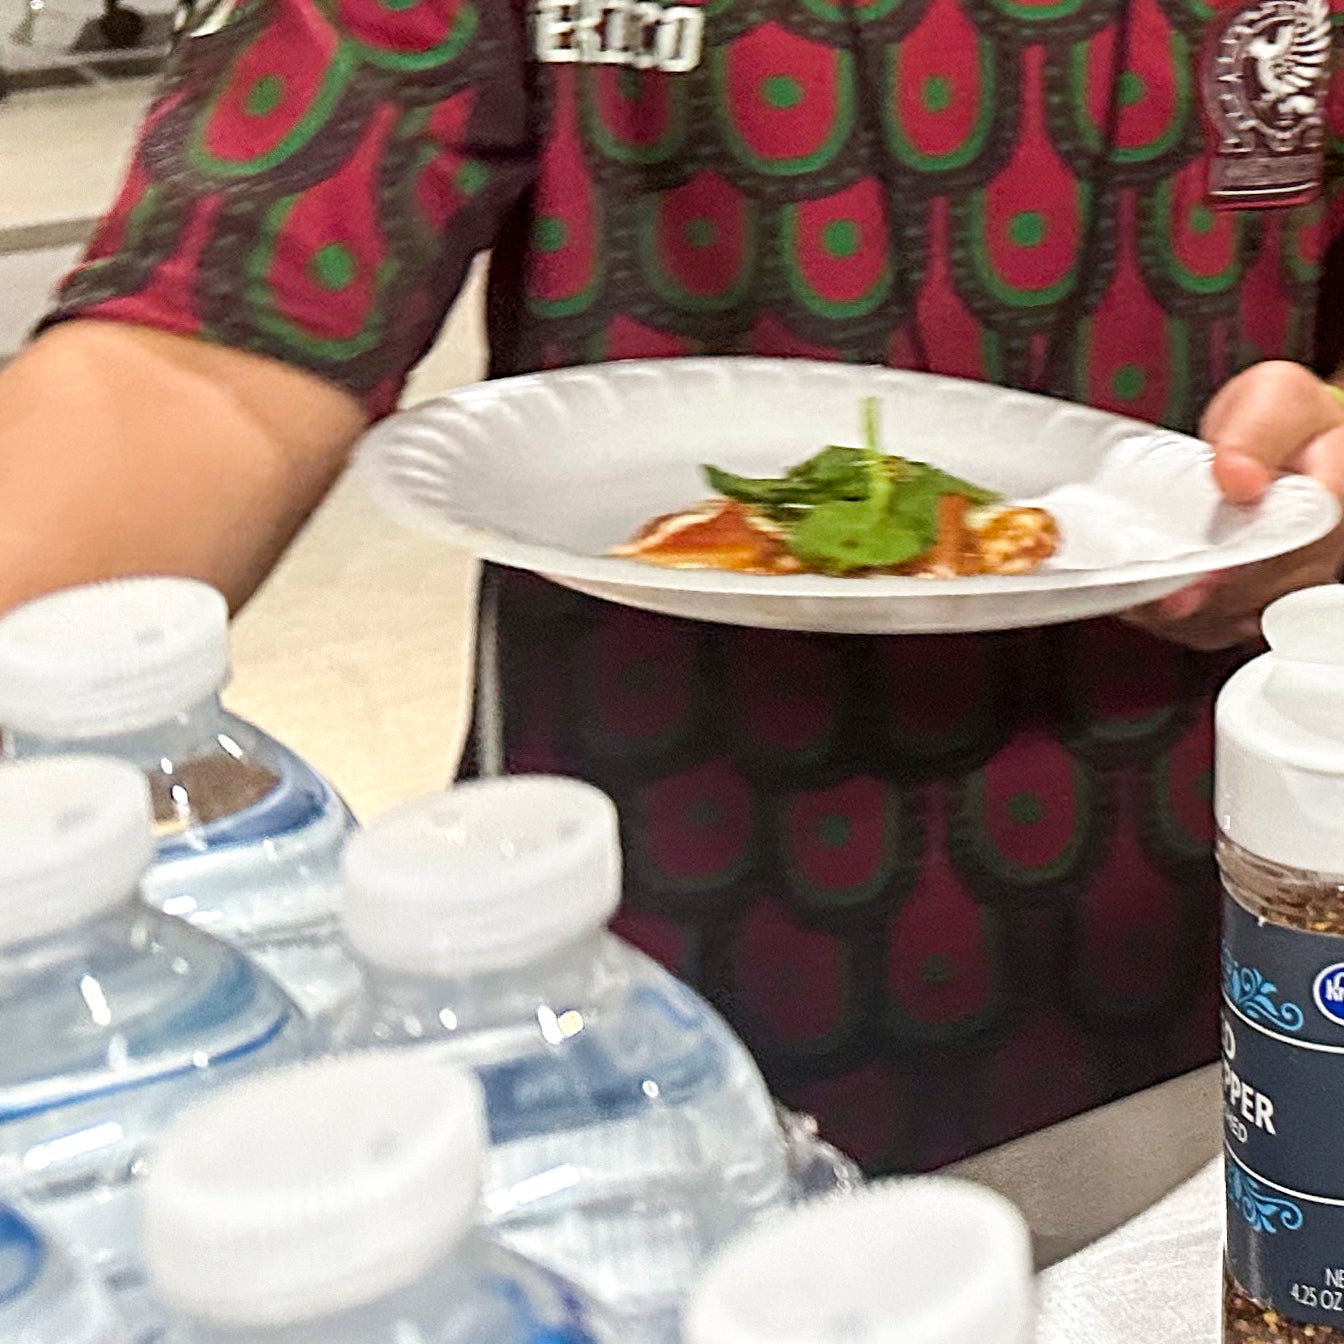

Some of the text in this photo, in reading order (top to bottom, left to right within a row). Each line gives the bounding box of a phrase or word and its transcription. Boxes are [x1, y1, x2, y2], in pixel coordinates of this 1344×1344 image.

[1223, 1054, 1277, 1137] PPER
[1290, 1283, 1318, 1307] 4.25
[1320, 1290, 1344, 1312] OZ
